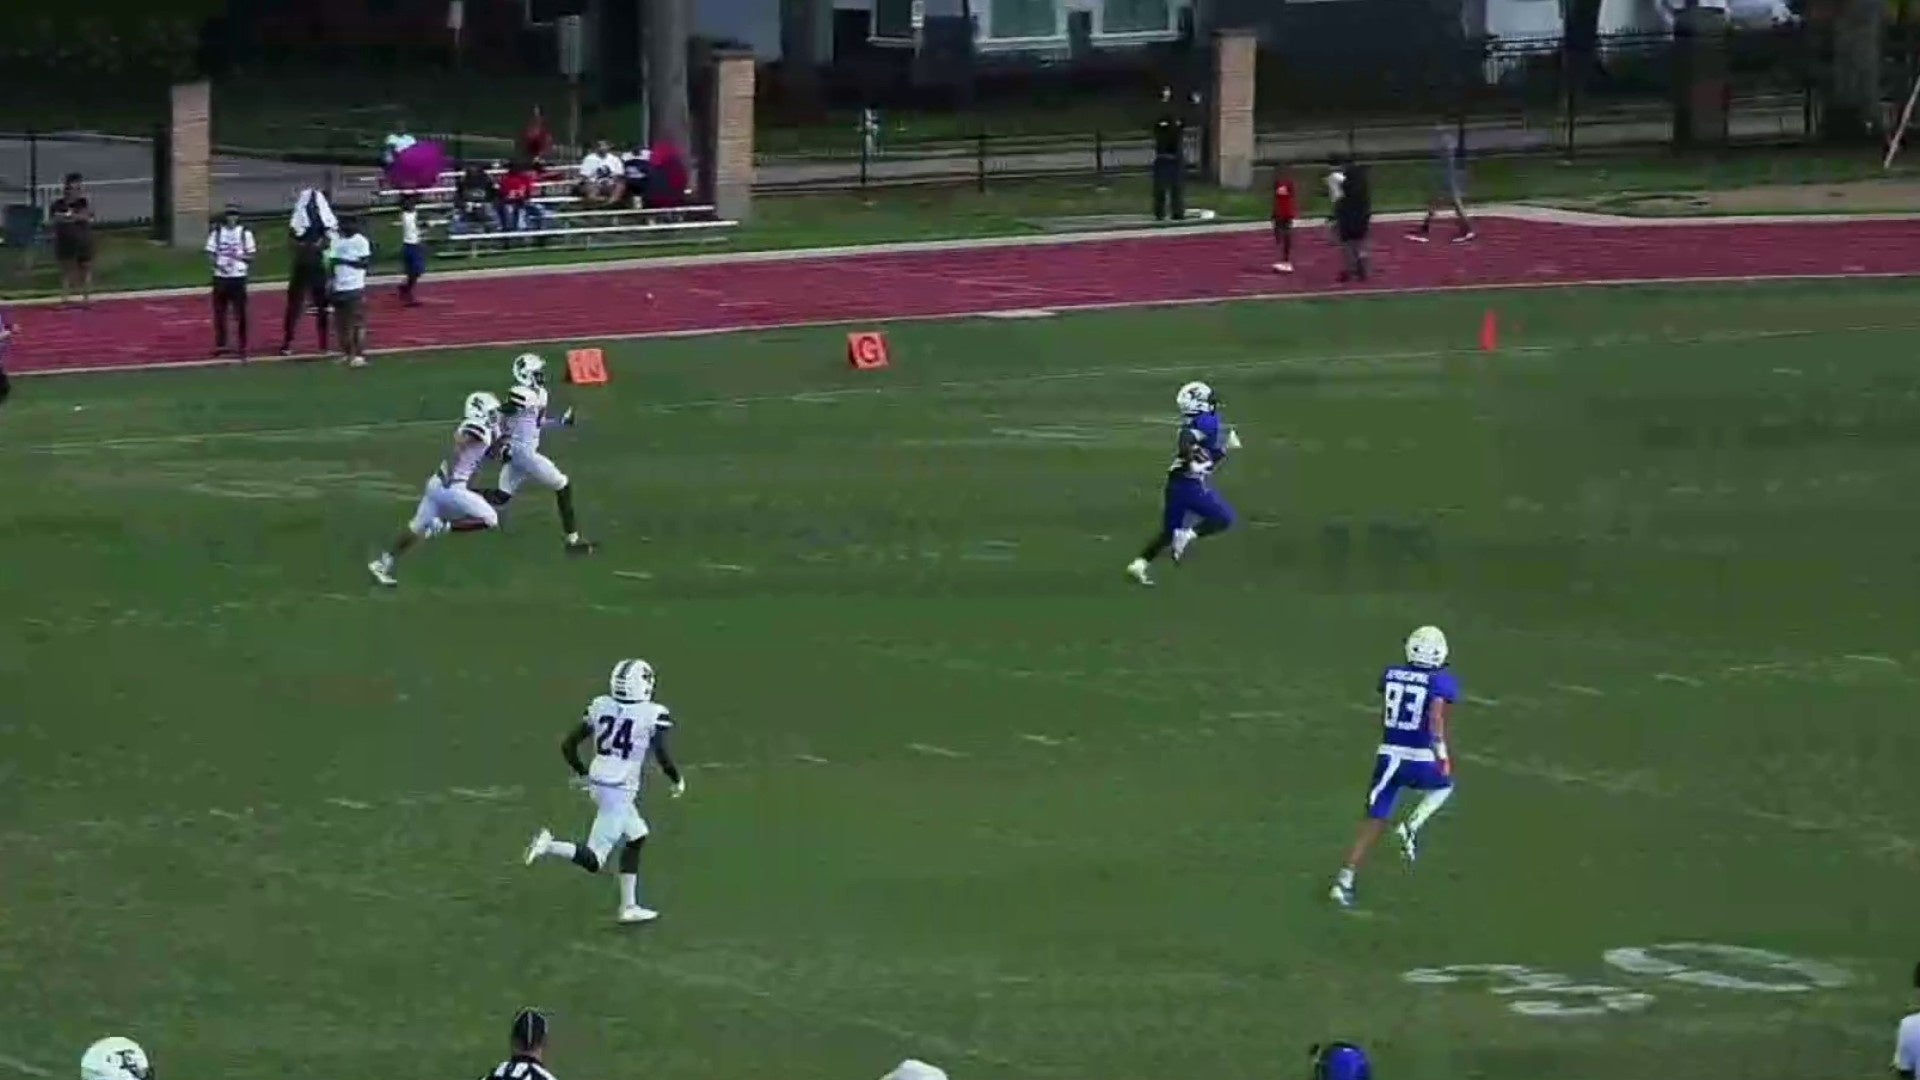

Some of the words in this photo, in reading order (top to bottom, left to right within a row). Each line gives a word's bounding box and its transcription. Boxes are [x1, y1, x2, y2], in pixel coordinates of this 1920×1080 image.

[858, 335, 878, 363] G
[1385, 681, 1428, 730] 83
[596, 715, 634, 760] 24
